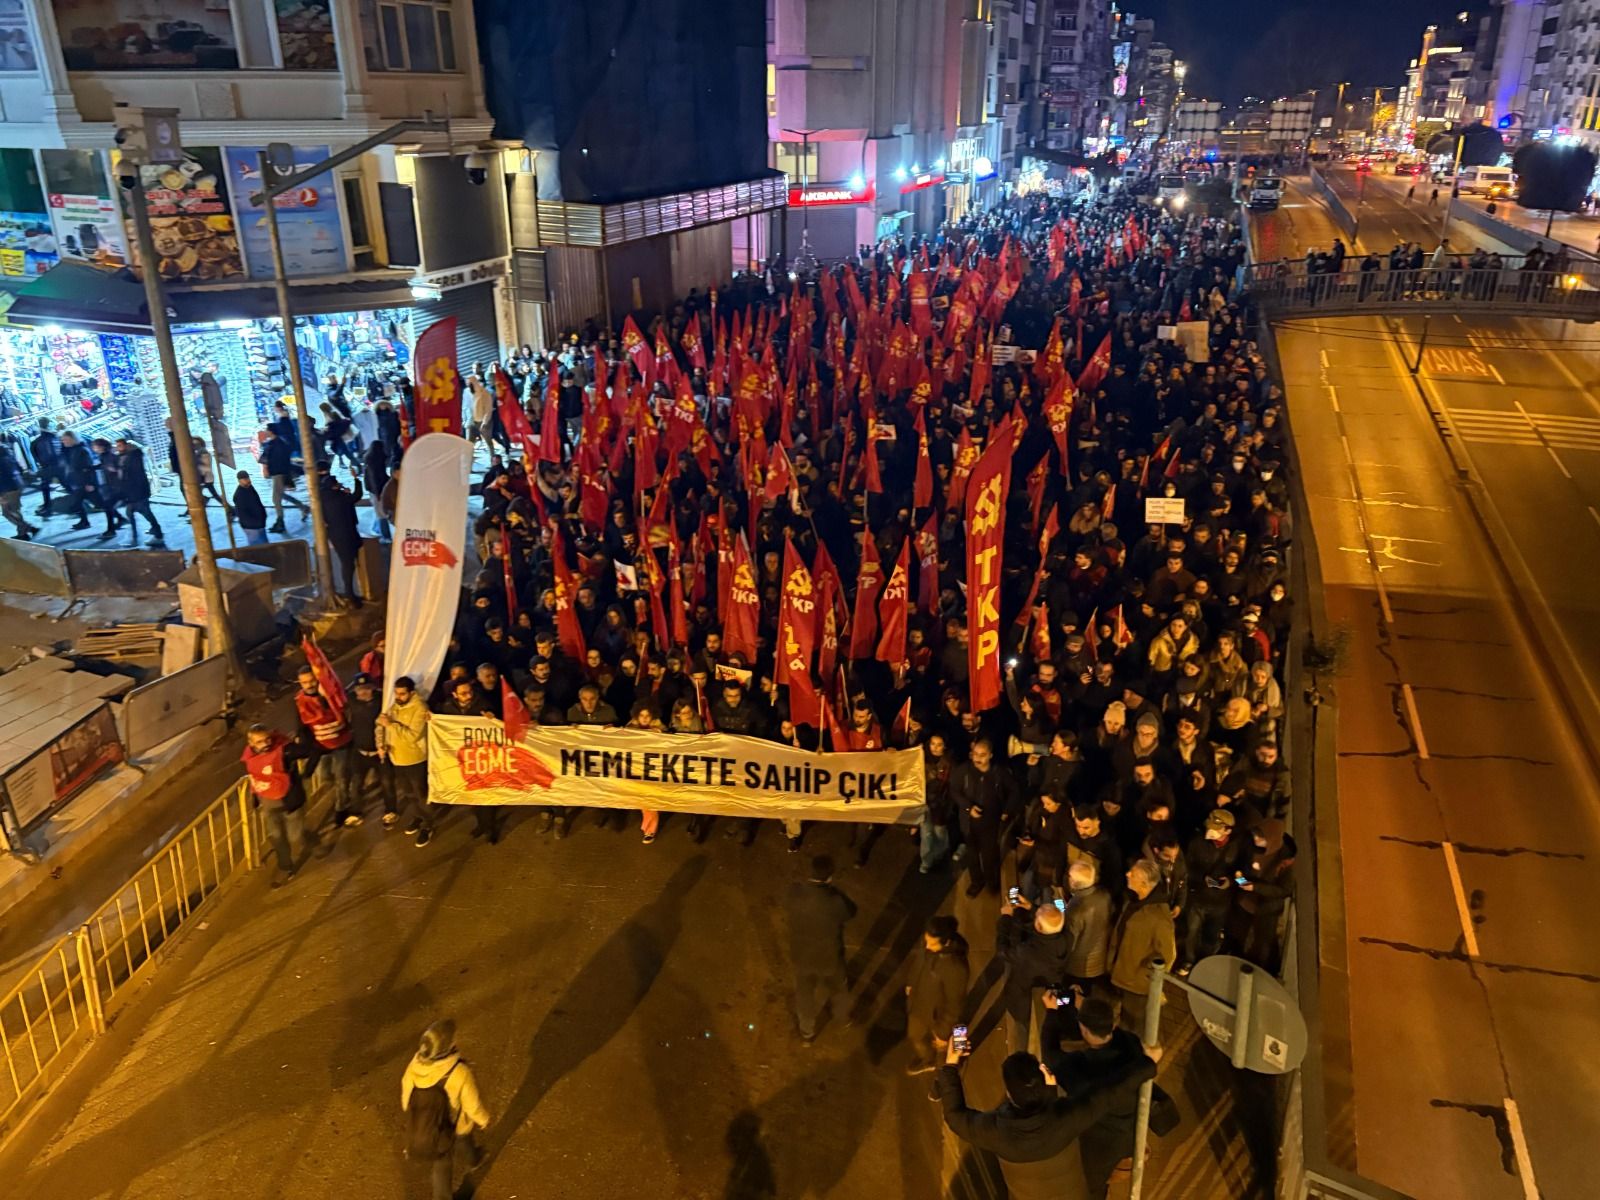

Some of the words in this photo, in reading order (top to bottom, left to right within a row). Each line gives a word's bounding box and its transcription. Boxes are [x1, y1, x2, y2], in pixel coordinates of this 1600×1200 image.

[800, 191, 852, 201] AKBANK
[405, 541, 438, 558] EGME
[975, 545, 1000, 670] TKP
[463, 747, 519, 776] EGME
[560, 748, 737, 787] MEMLEKETE
[744, 761, 831, 795] SAHİP
[838, 771, 898, 804] ÇIK!
